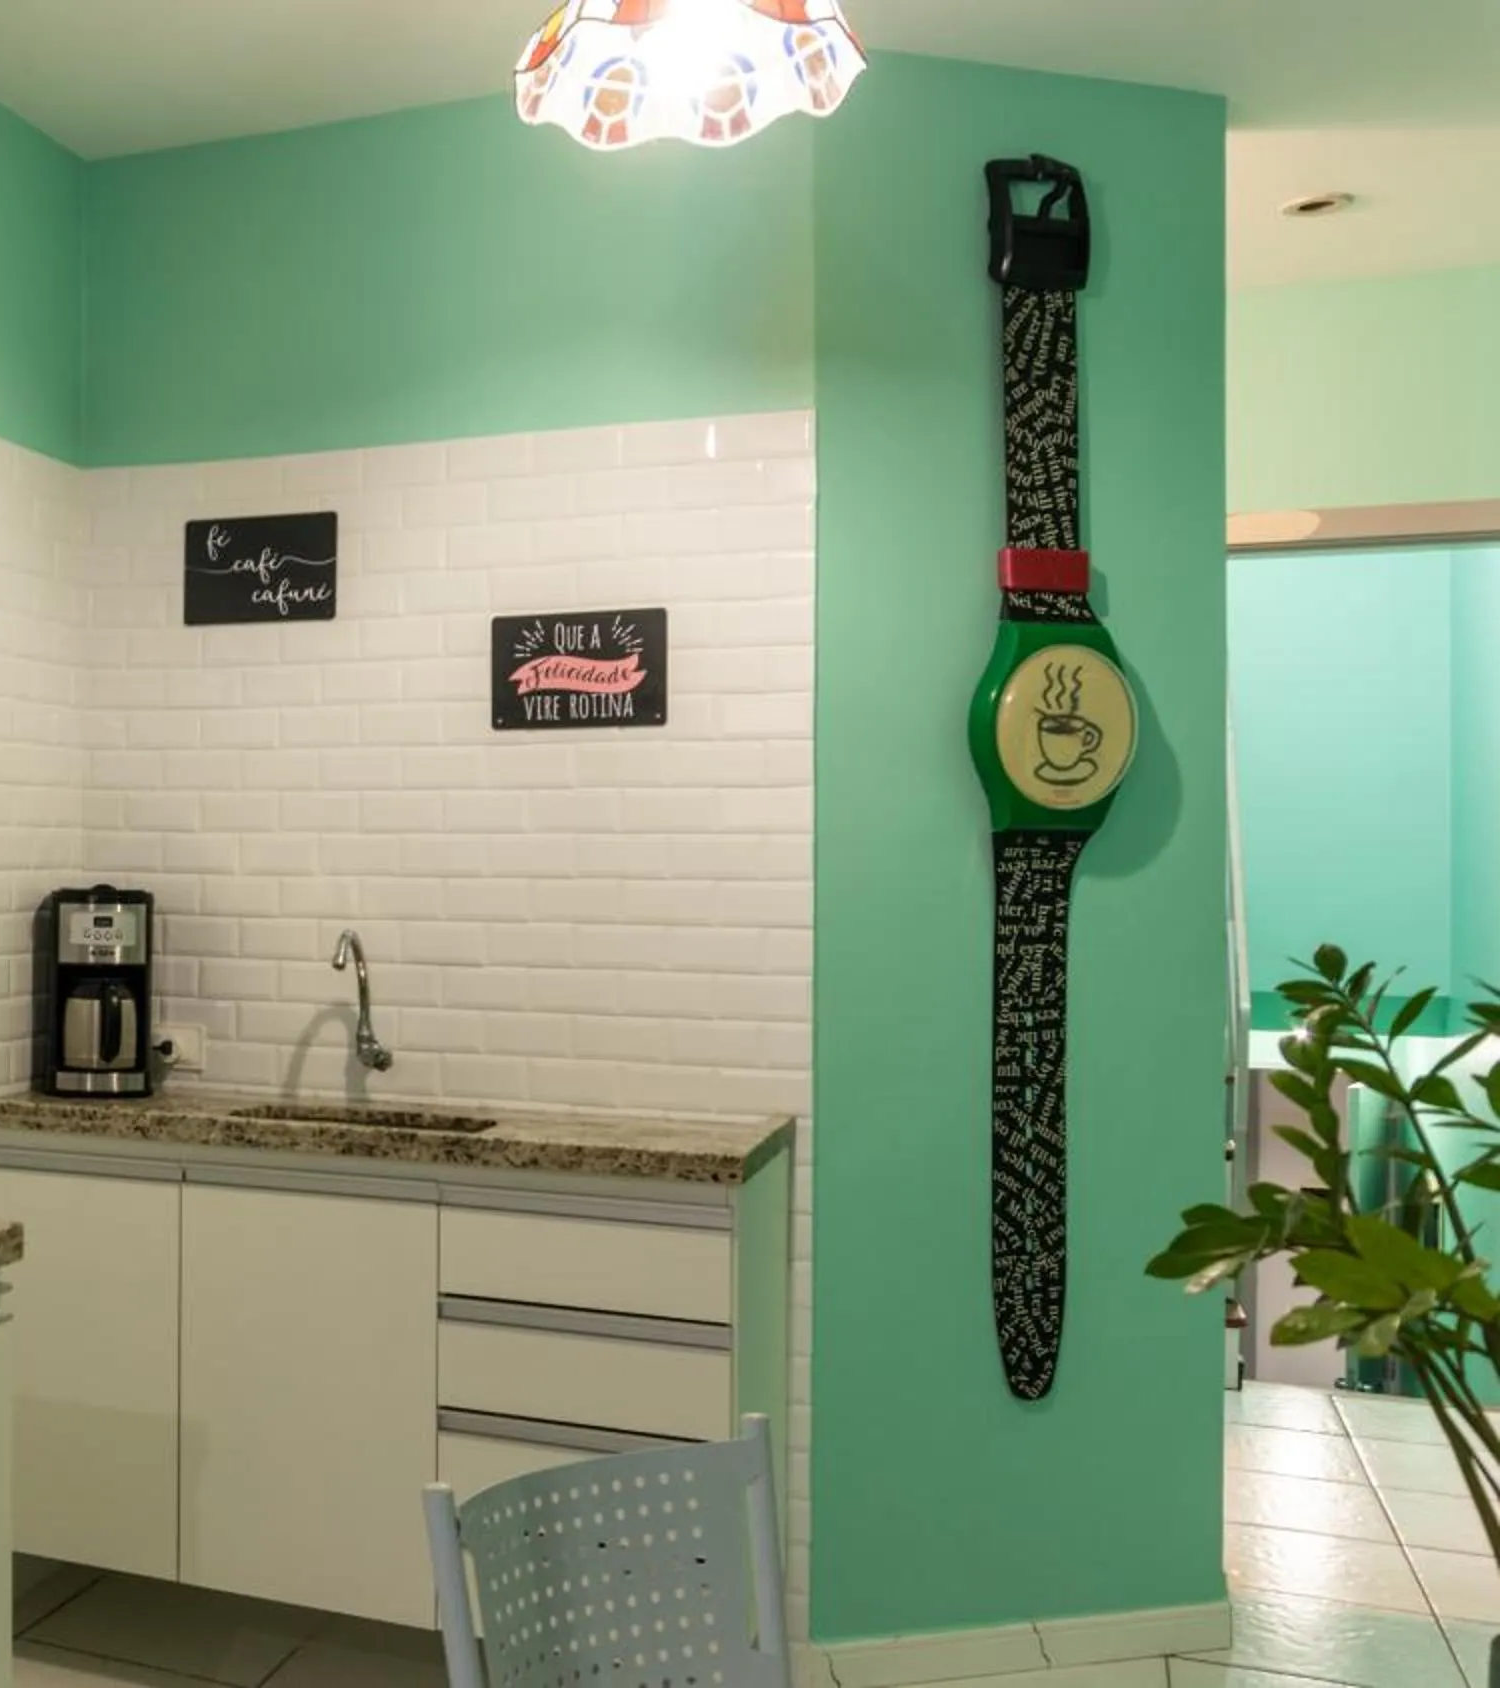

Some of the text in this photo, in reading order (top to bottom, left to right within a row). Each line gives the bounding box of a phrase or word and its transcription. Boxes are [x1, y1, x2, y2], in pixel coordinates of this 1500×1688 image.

[231, 547, 284, 584] café
[554, 622, 601, 654] QUE A
[524, 659, 631, 689] Felicidade
[523, 692, 634, 721] VIRE ROTINA
